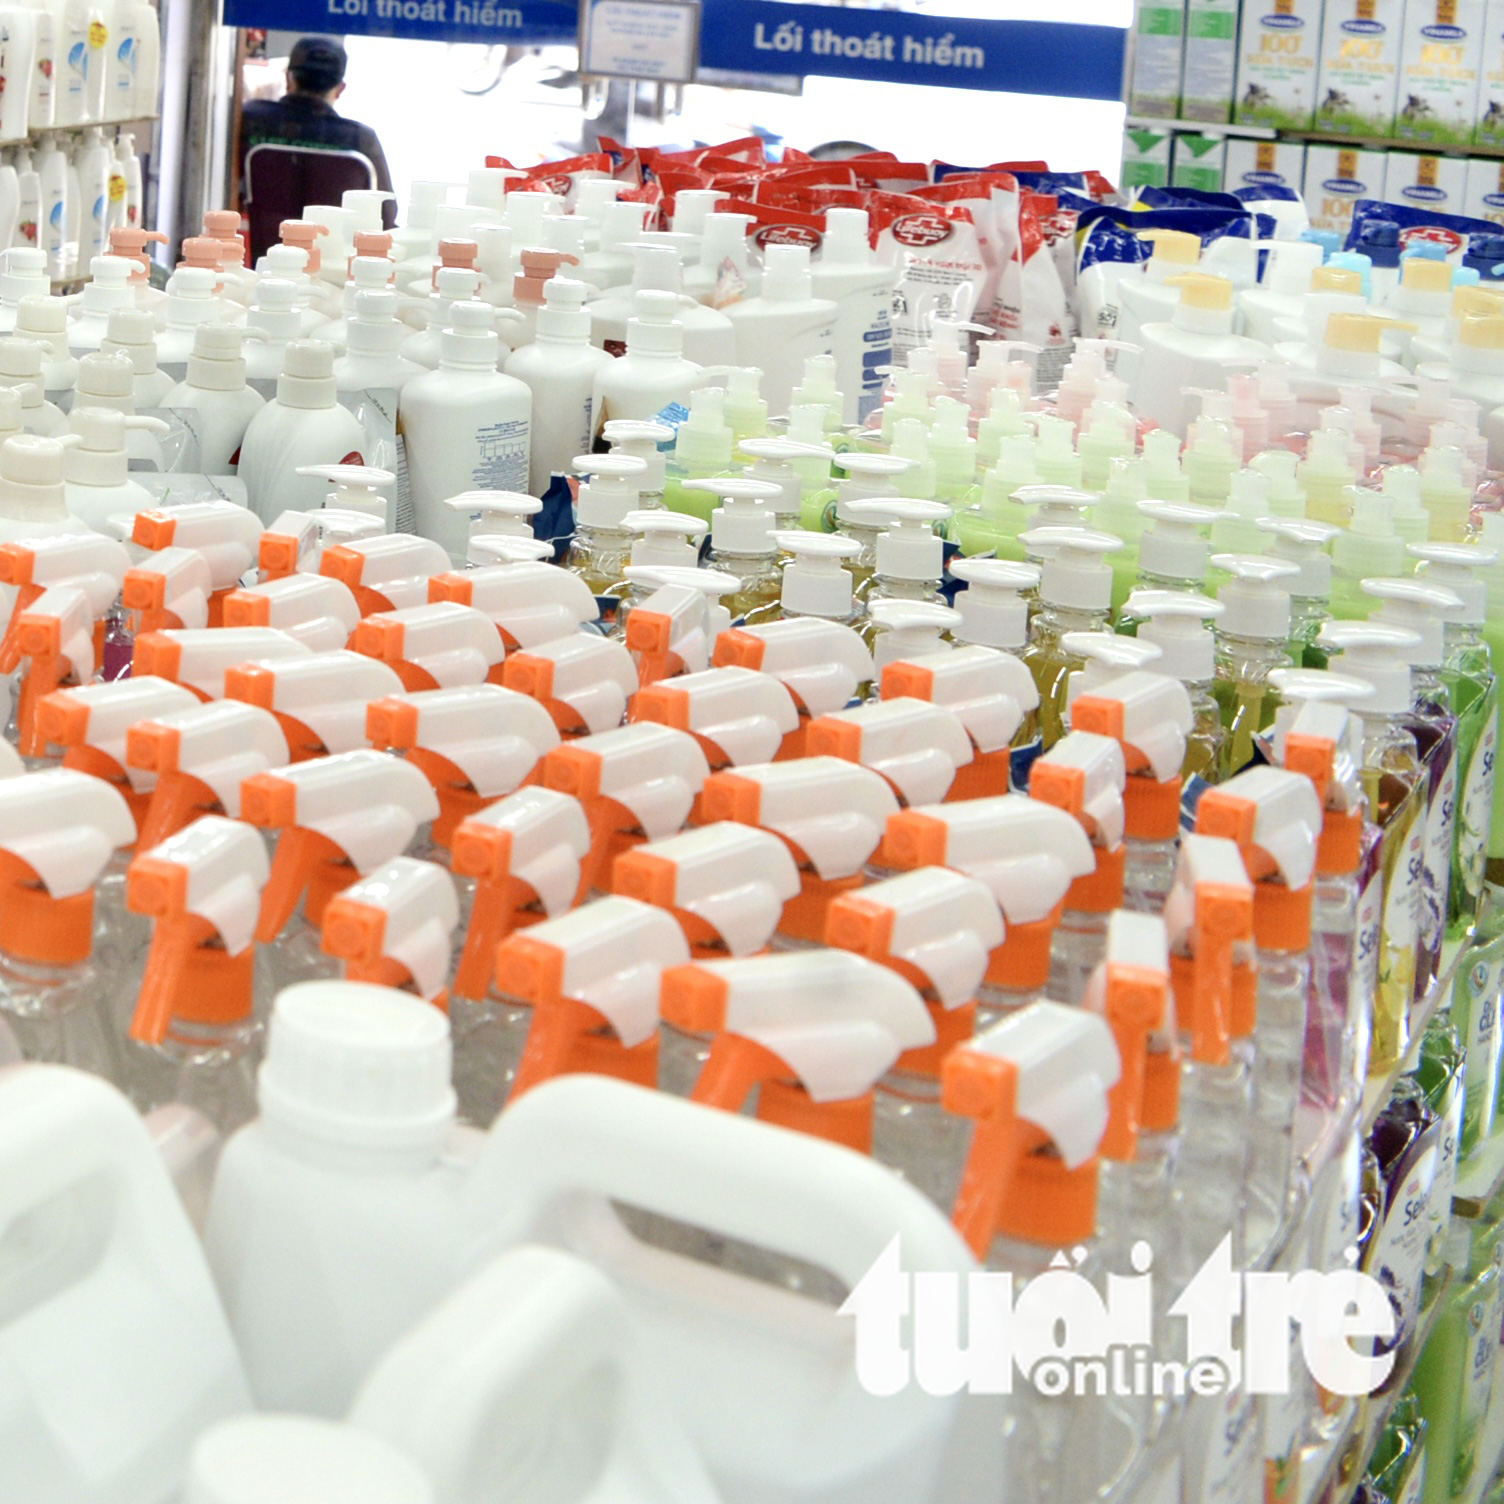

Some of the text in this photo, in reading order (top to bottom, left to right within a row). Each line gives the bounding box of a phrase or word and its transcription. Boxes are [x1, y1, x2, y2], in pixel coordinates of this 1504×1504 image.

[754, 20, 984, 69] Lối thoát hiểm
